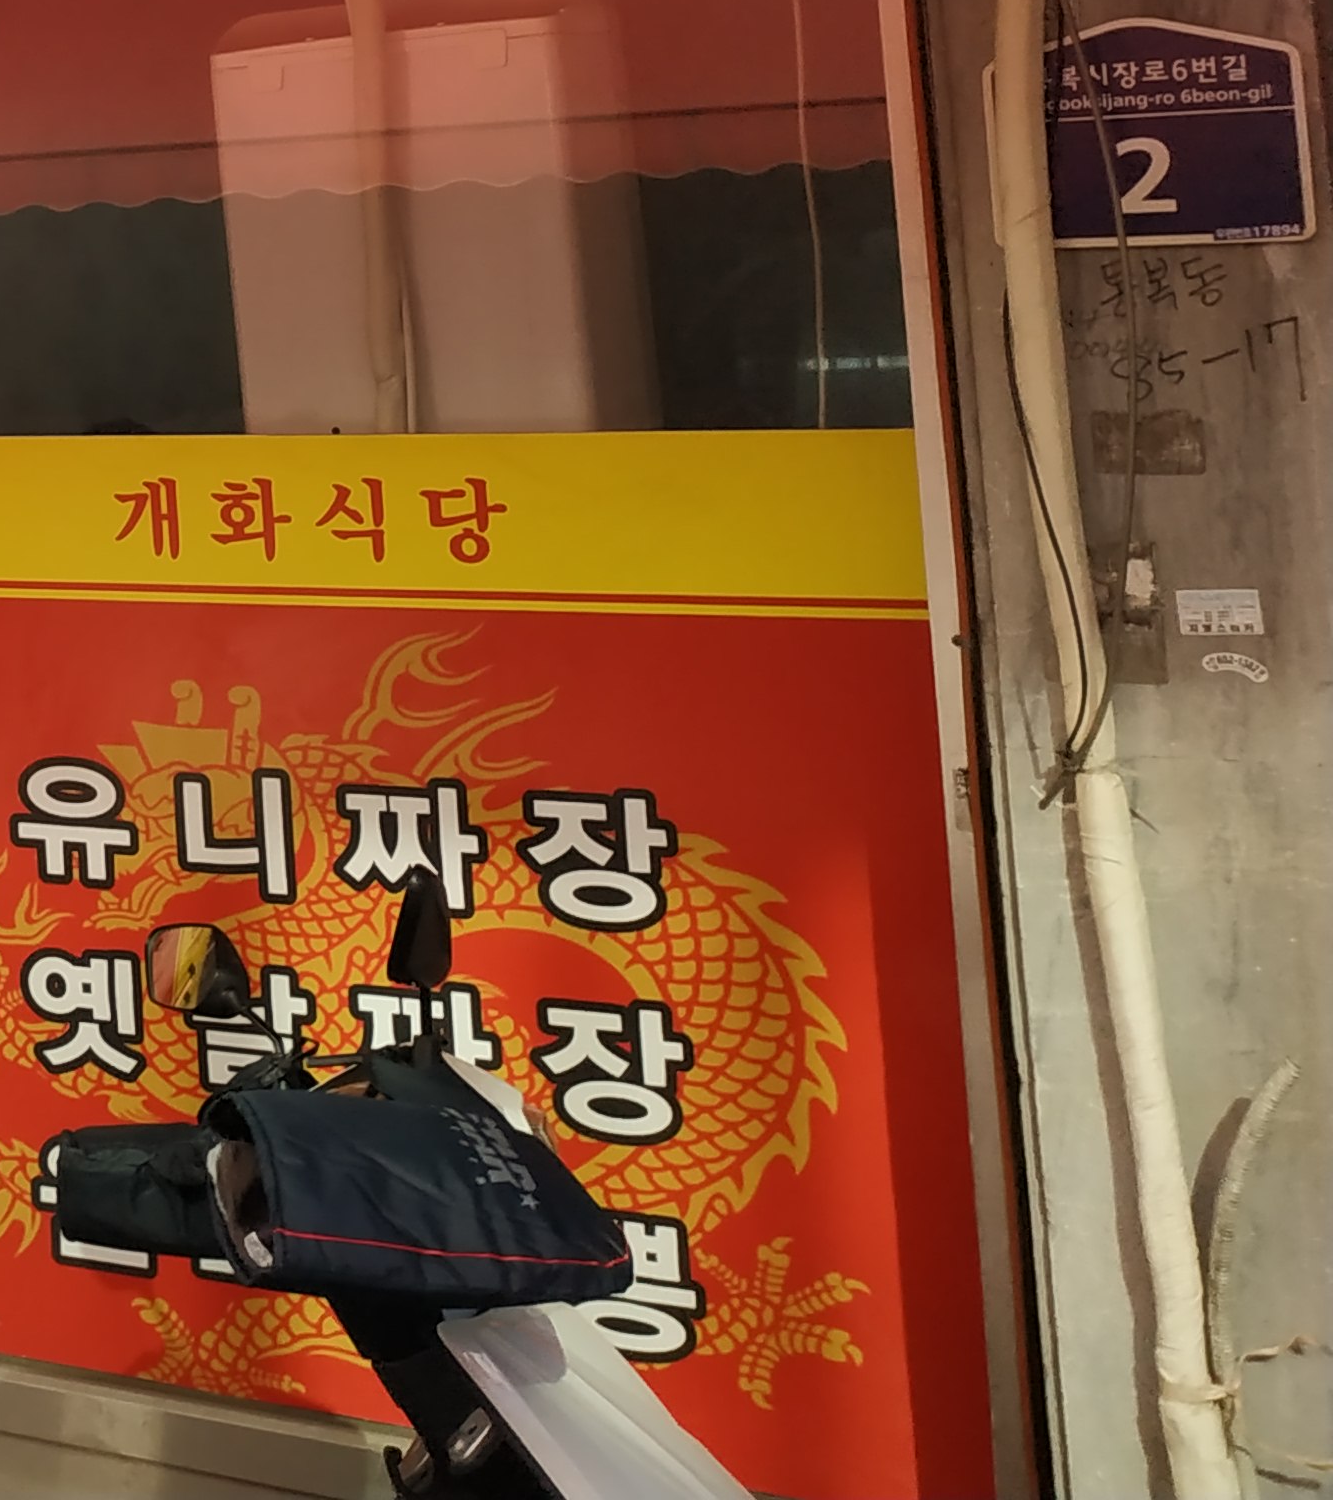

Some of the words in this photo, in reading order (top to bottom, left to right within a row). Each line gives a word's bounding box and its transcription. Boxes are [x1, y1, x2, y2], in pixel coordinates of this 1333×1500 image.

[1180, 84, 1272, 106] 6beon-gil
[1116, 137, 1178, 214] 2
[113, 475, 508, 564] 개화식당
[10, 755, 681, 932] 유니짜장
